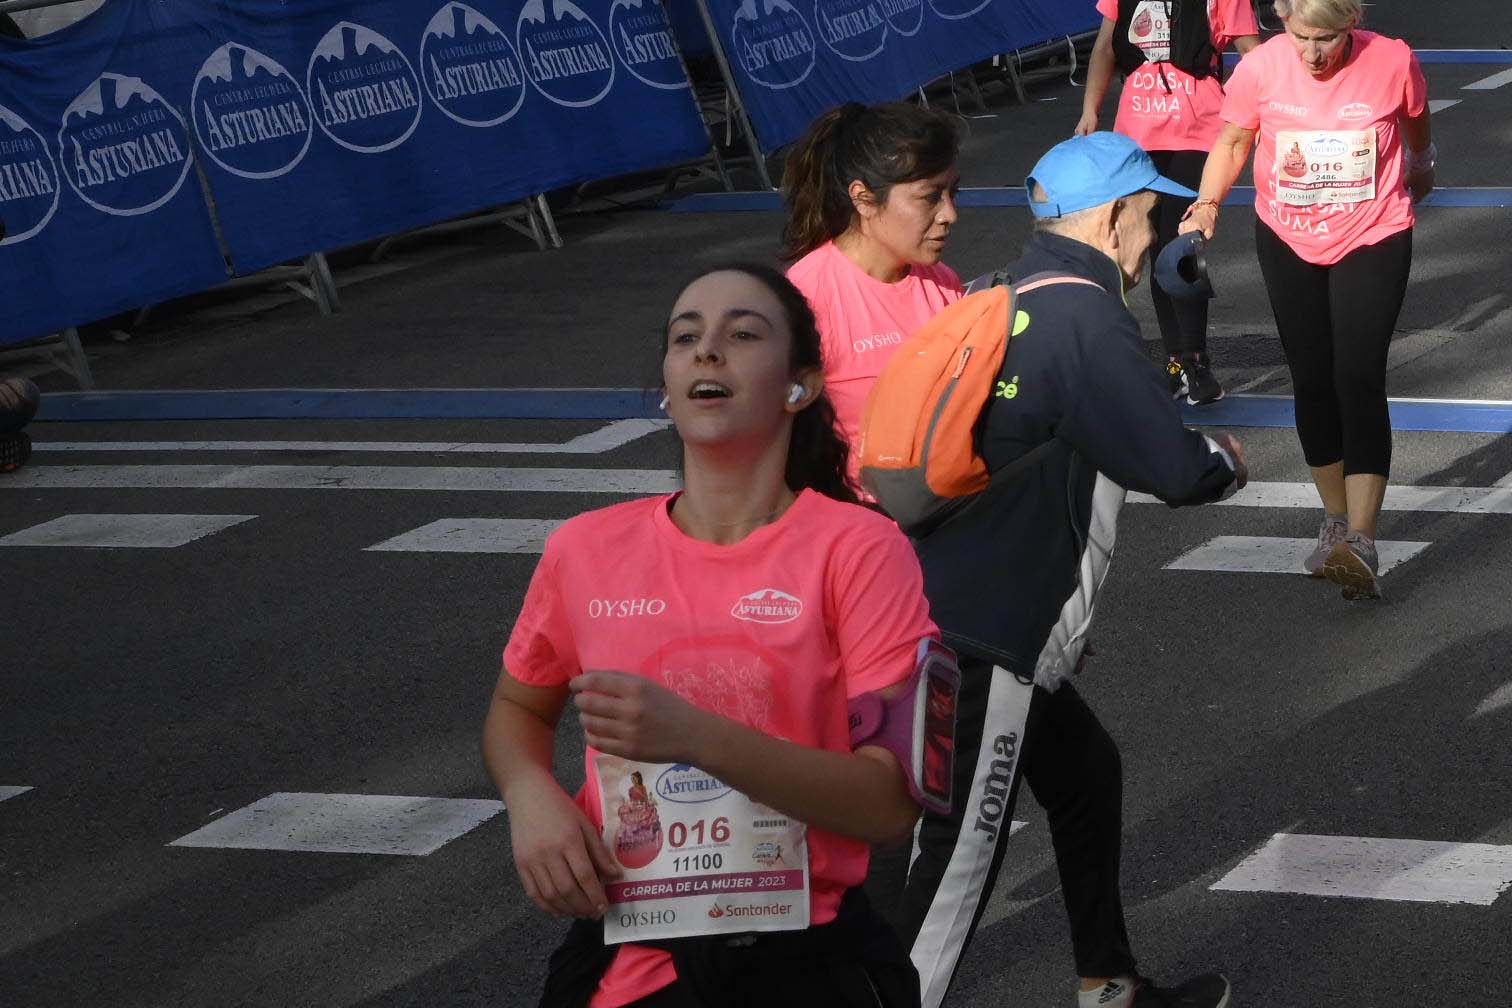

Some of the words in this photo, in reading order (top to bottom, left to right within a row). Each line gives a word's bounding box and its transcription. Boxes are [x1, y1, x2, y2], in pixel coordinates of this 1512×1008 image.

[525, 38, 611, 82] ASTURIANA
[429, 52, 522, 101] ASTURIANA
[316, 76, 418, 127] ASTURIANA
[202, 99, 308, 151] ASTURIANA
[1310, 162, 1343, 173] 016
[1268, 200, 1330, 235] SUMA
[853, 331, 901, 354] OYSHO
[588, 598, 667, 618] OYSHO
[736, 601, 800, 618] ASTURIANA
[668, 816, 731, 848] 016
[672, 852, 723, 873] 11100
[623, 884, 674, 898] CARRERA
[675, 882, 692, 893] DE
[694, 881, 708, 891] LA
[711, 878, 753, 890] MUJER
[758, 876, 786, 887] 2023
[620, 909, 676, 929] OYSHO
[726, 902, 793, 918] Santander
